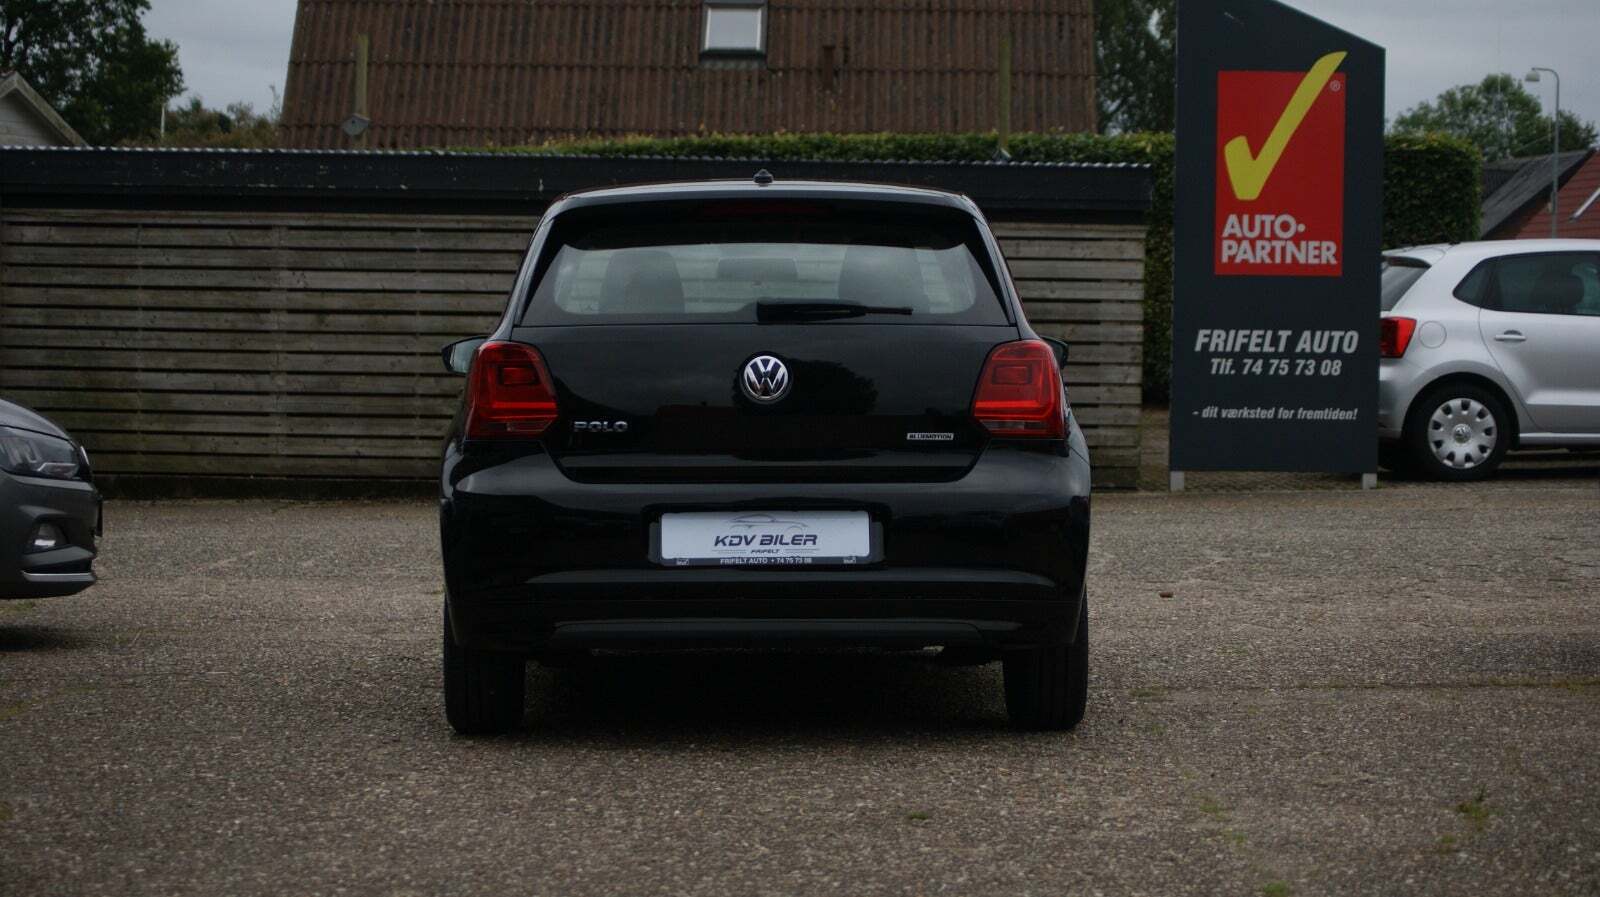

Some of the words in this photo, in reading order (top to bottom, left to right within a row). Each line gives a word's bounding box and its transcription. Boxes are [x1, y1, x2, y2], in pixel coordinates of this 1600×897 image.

[1221, 240, 1337, 265] PARTNER
[1194, 329, 1292, 353] FRIFELT
[1295, 330, 1360, 354] AUTO
[1210, 358, 1237, 375] Tlf.
[1242, 359, 1263, 375] 74
[1268, 359, 1290, 376] 75
[1295, 359, 1315, 376] 73
[1320, 359, 1342, 376] 08
[1202, 406, 1218, 418] dit
[1221, 407, 1275, 419] værksted
[1277, 407, 1294, 419] for
[1297, 407, 1358, 420] fremtiden!
[573, 420, 628, 433] POLO
[714, 535, 757, 547] KDV
[759, 534, 818, 546] BILER
[720, 557, 748, 565] FRIFELT
